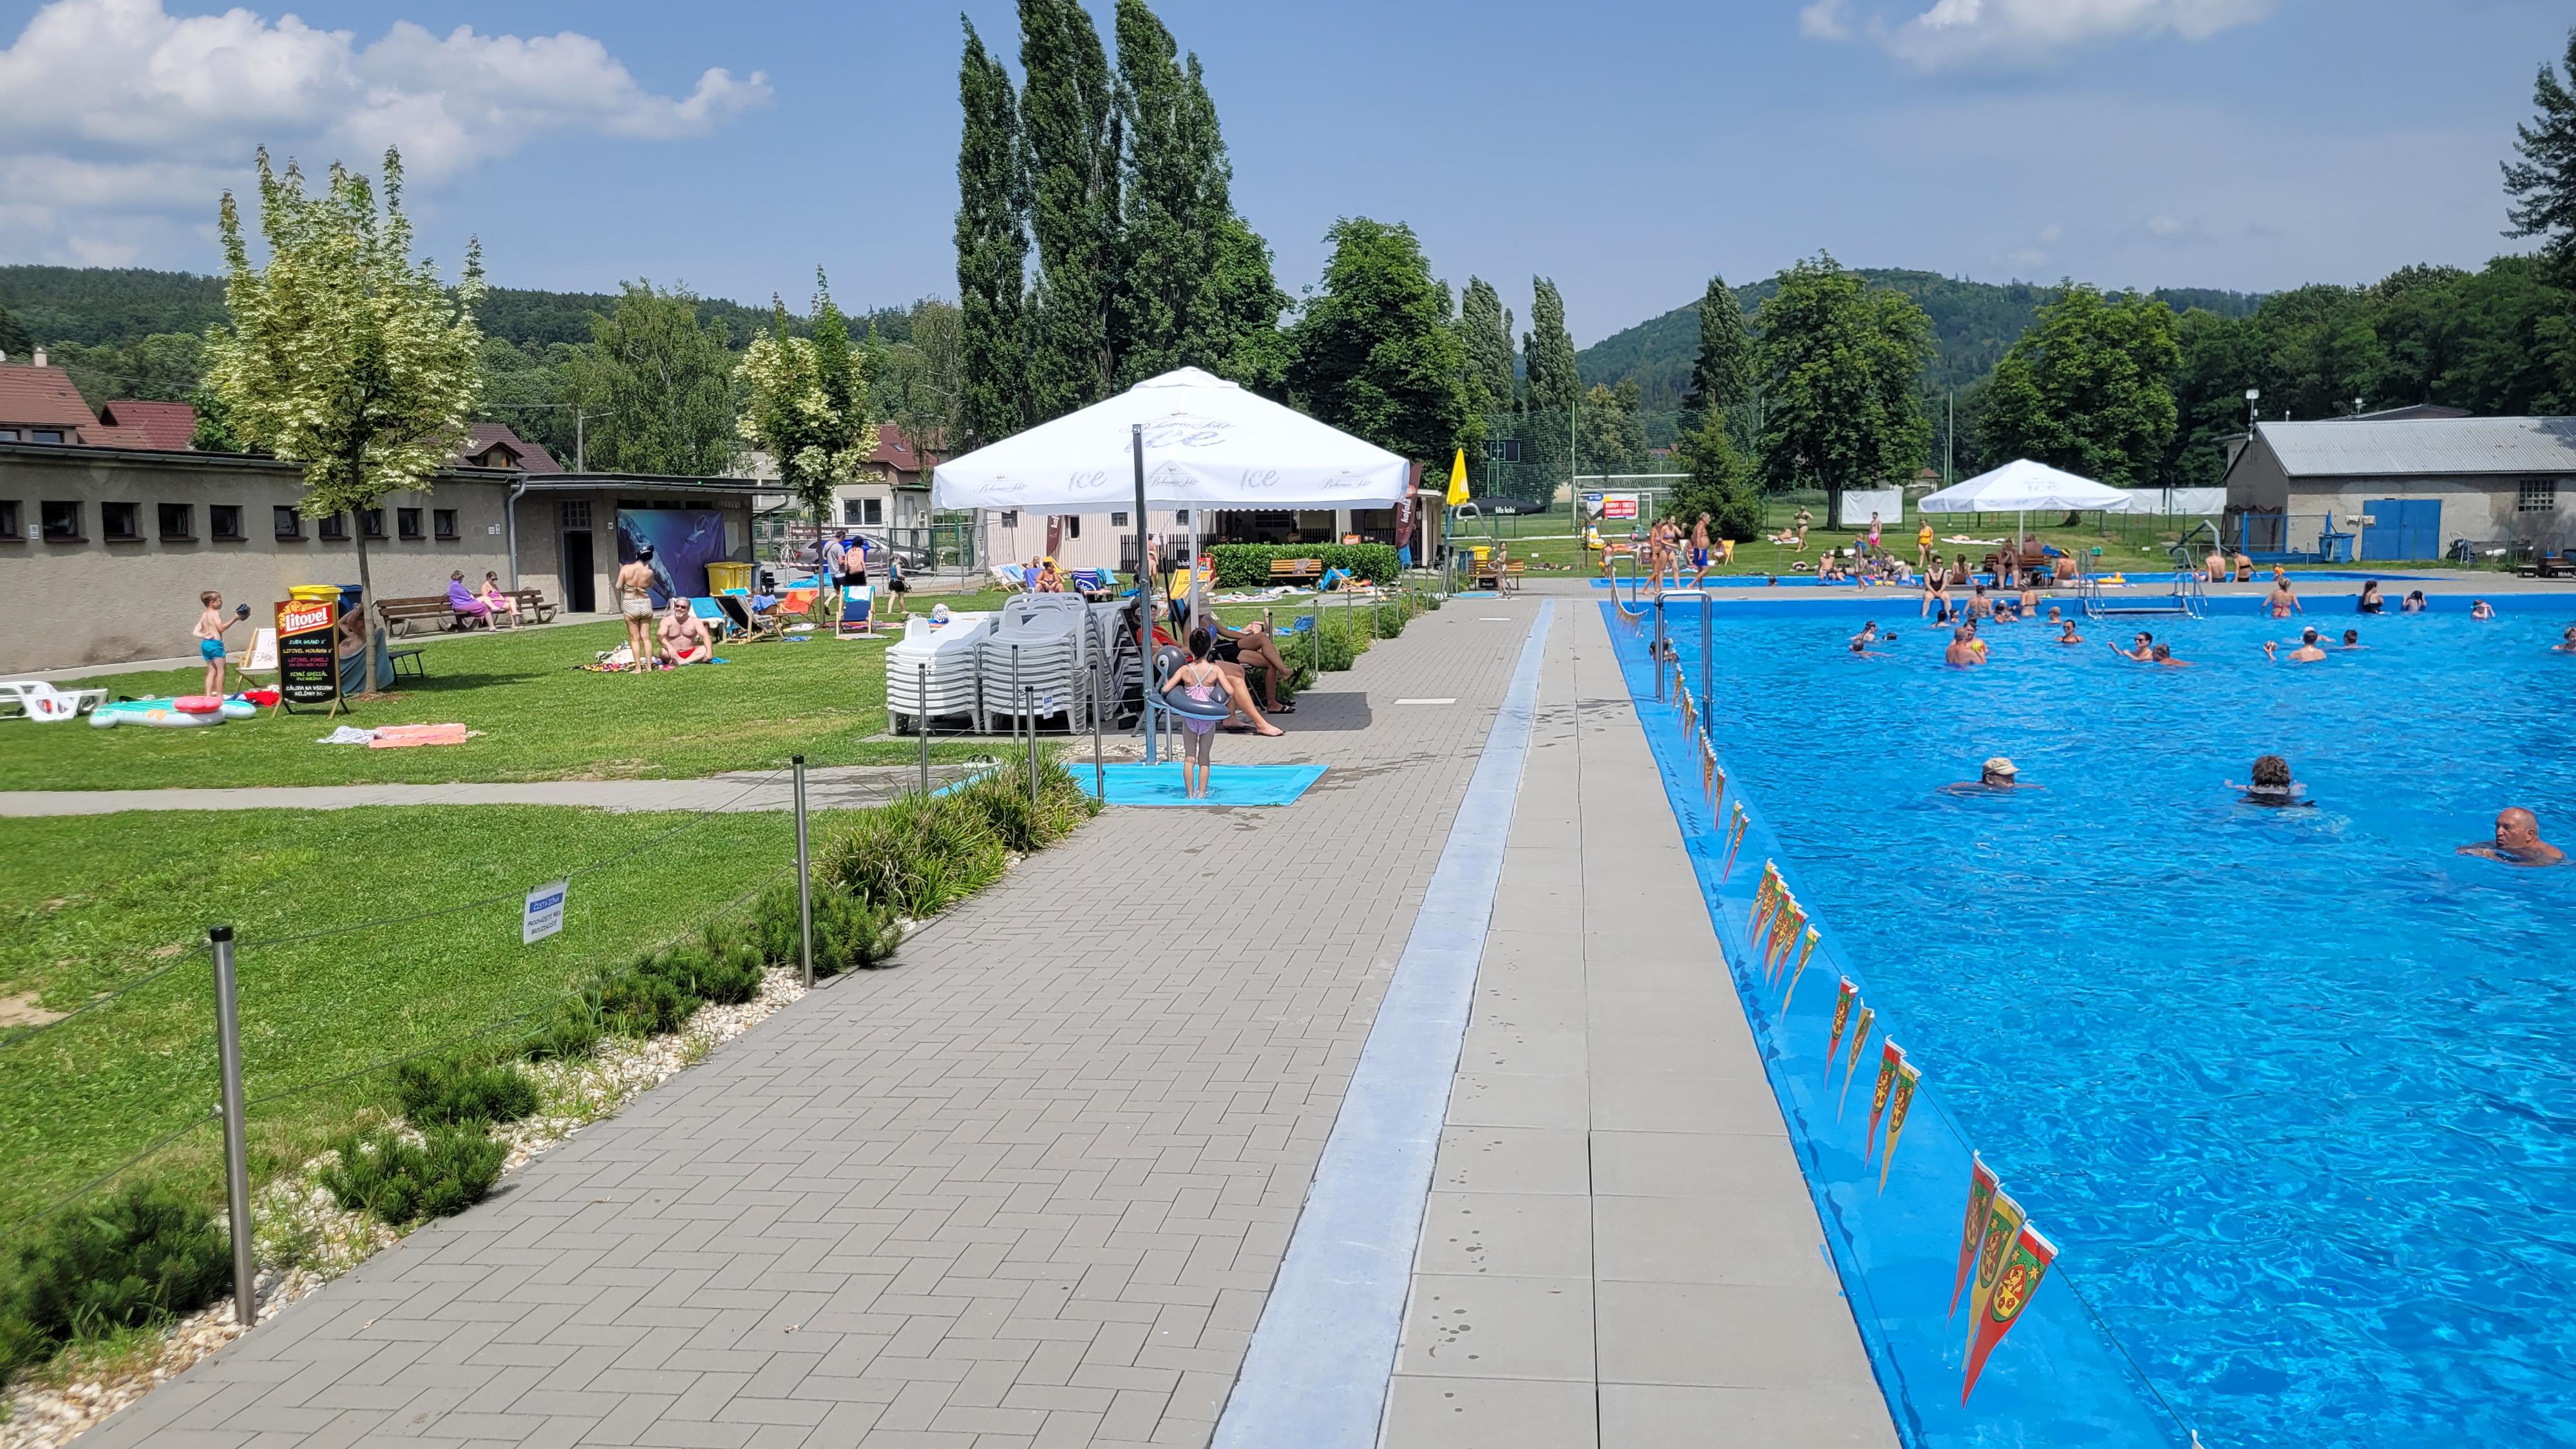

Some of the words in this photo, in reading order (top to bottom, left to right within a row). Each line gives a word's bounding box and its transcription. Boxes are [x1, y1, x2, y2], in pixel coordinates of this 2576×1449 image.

[1050, 515, 1060, 528] kof
[1401, 498, 1412, 523] kofola
[285, 607, 328, 632] Litovel
